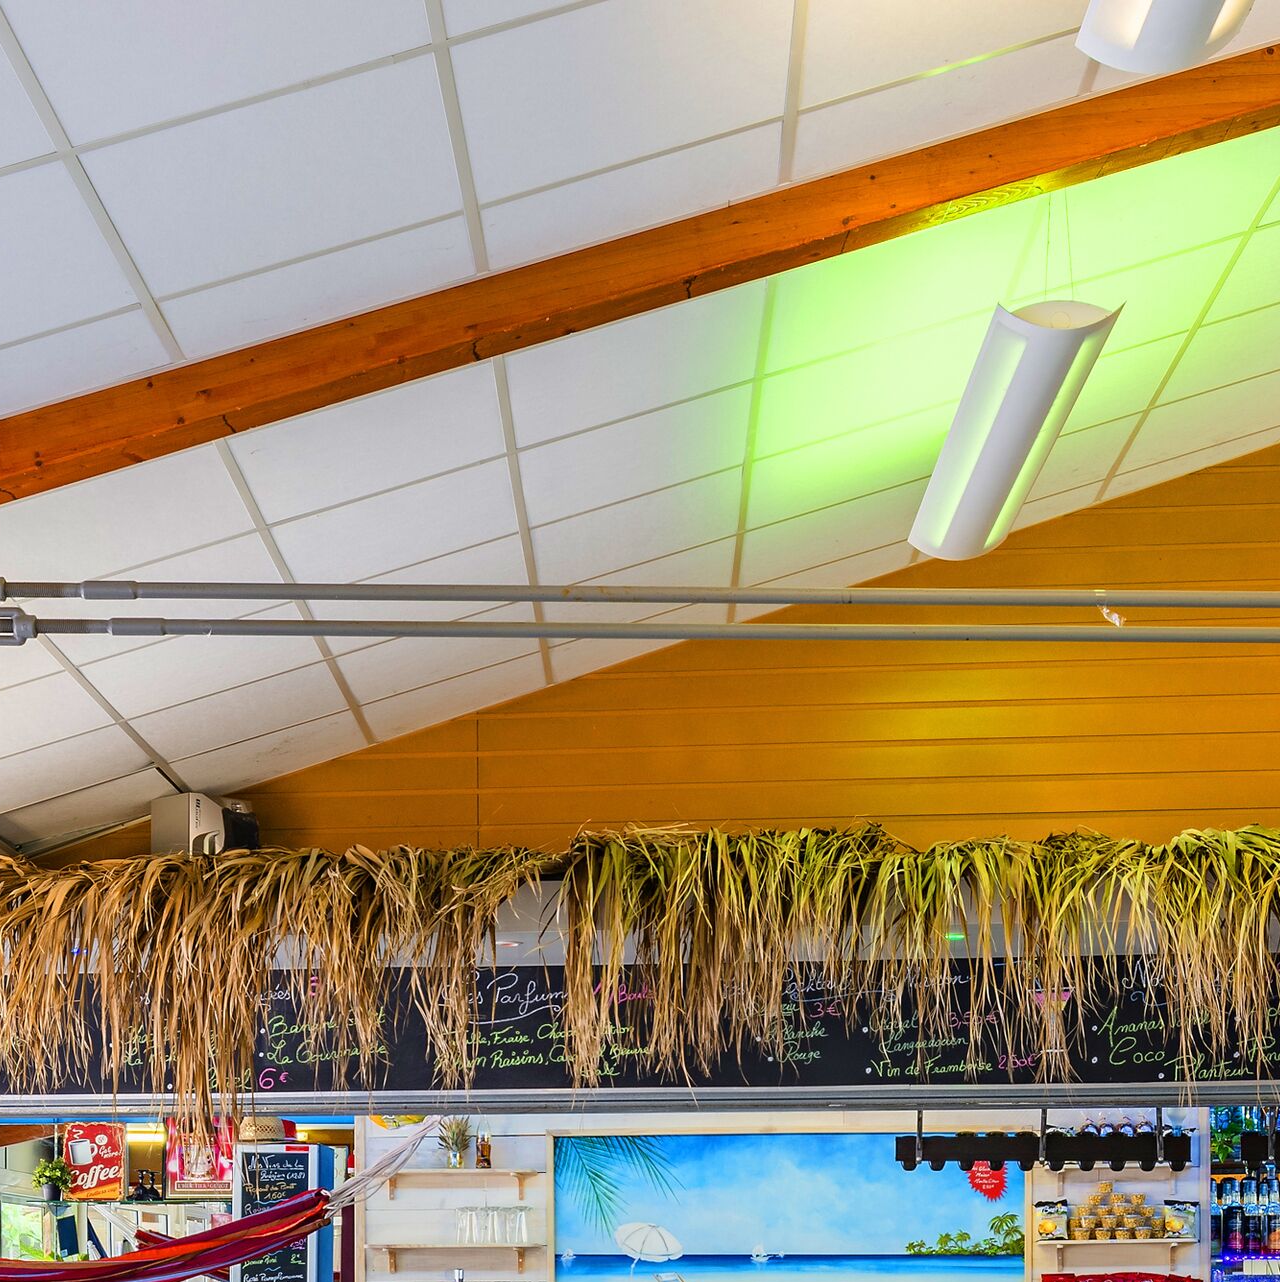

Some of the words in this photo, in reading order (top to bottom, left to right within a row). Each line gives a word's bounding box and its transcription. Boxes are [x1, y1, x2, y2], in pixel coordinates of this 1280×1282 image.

[810, 1000, 842, 1018] 3€
[490, 1026, 533, 1045] Fraise,
[1097, 1005, 1165, 1047] Ananas
[267, 1040, 293, 1064] La
[490, 1050, 549, 1070] Raisins,
[778, 1041, 822, 1064] Rouge
[1109, 1036, 1165, 1065] Coco
[871, 1059, 900, 1077] Vin
[905, 1063, 920, 1076] de
[1164, 1052, 1254, 1081] Planteur
[69, 1164, 120, 1189] Coffee
